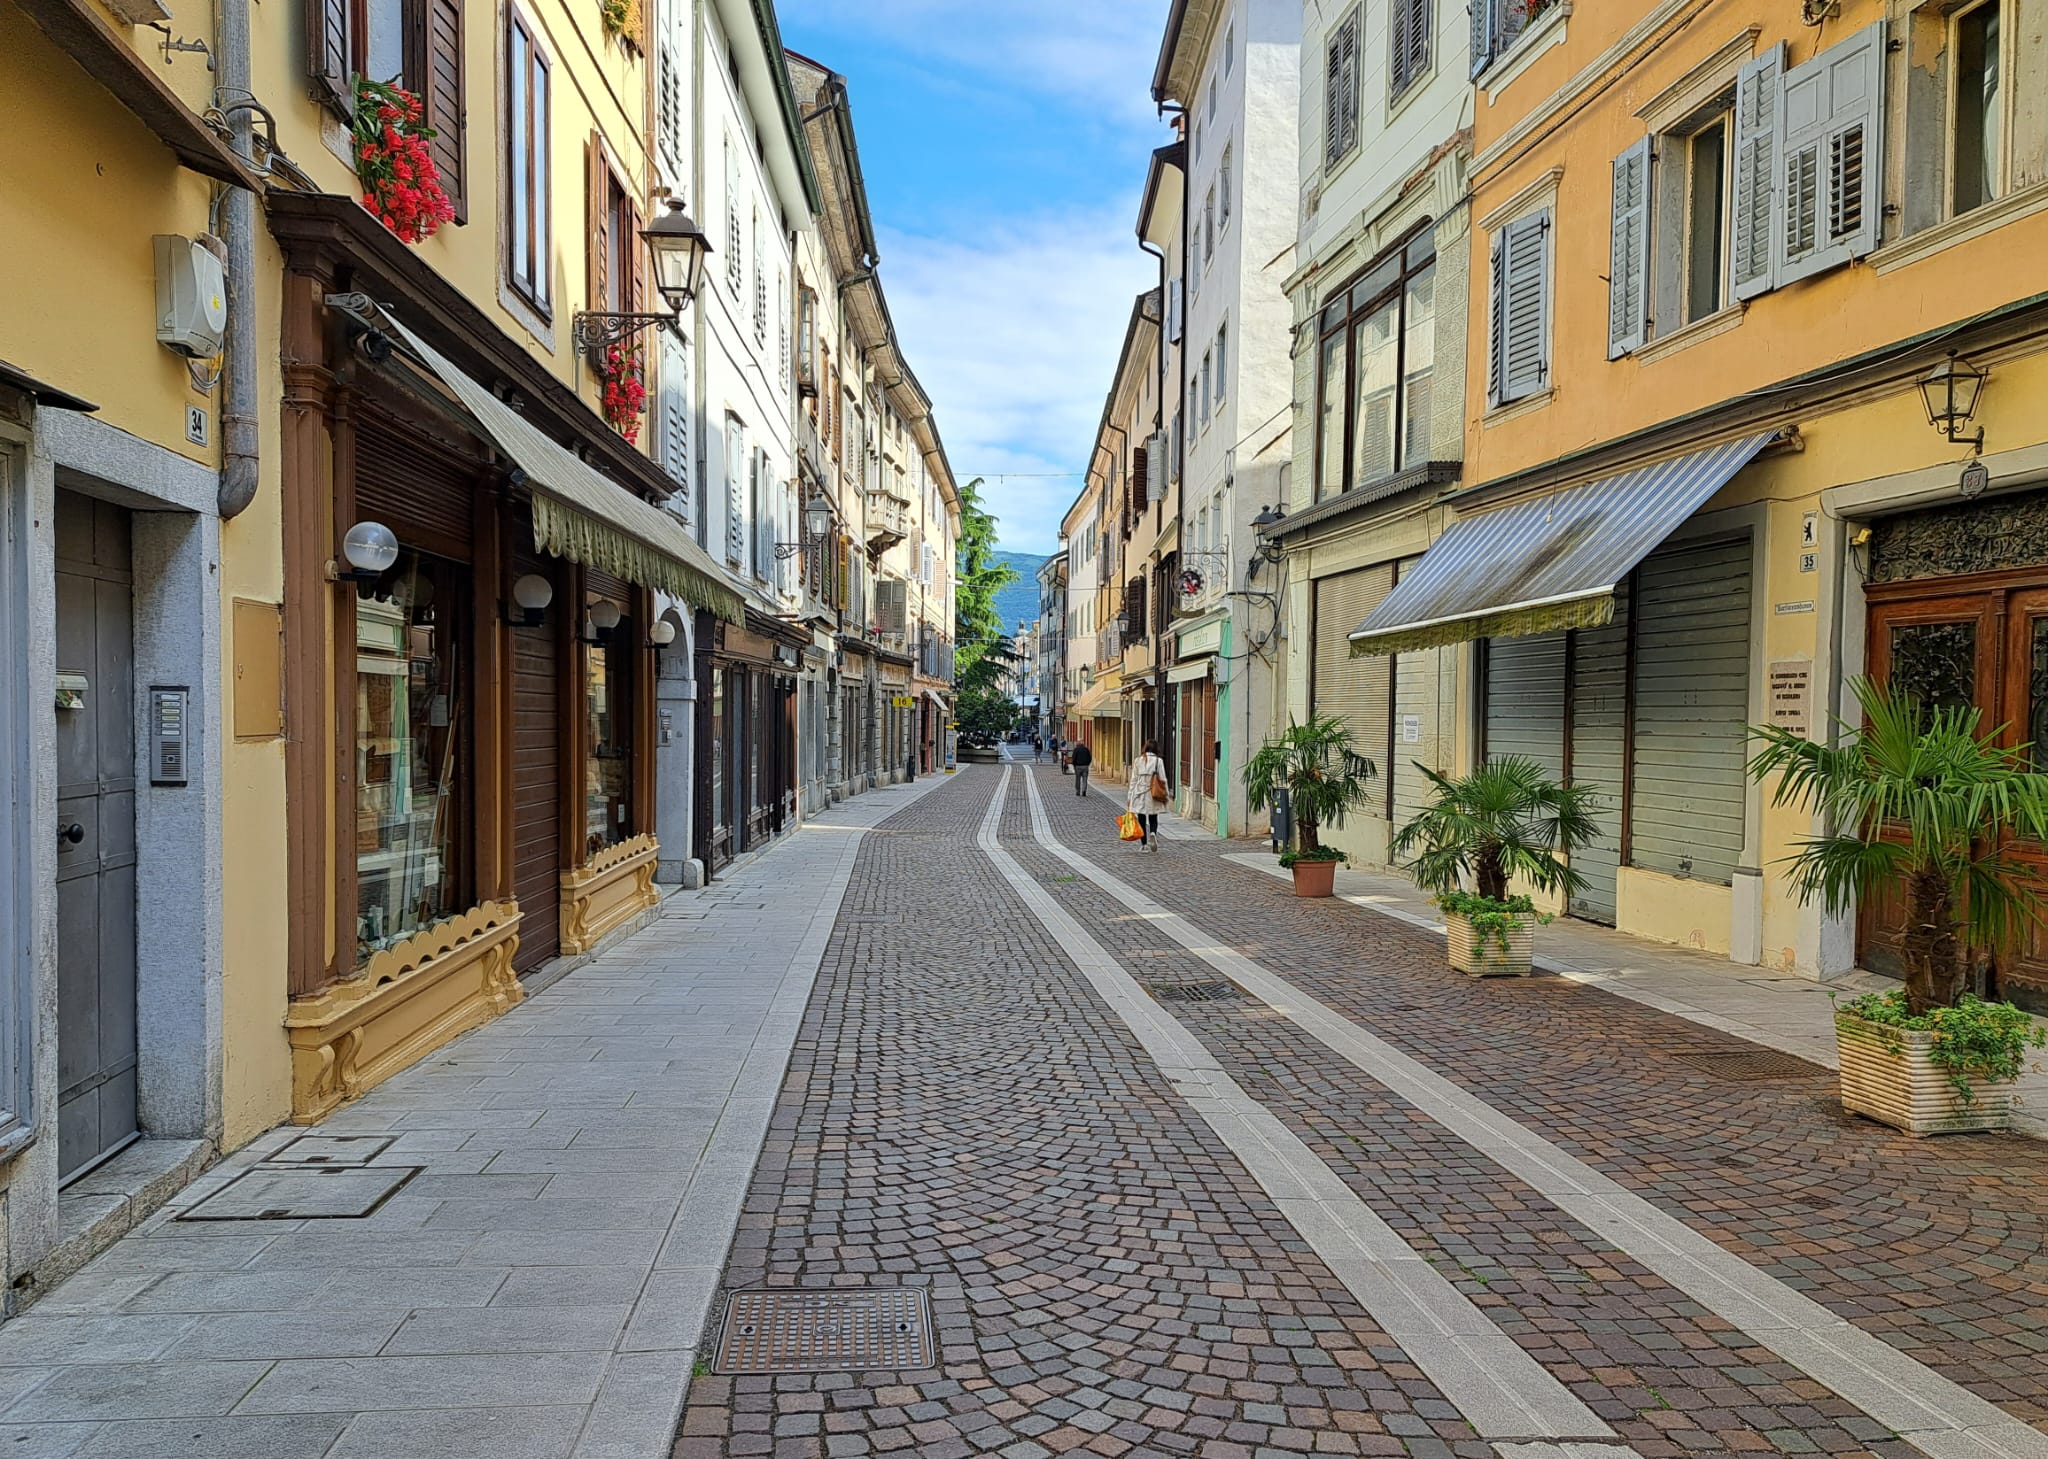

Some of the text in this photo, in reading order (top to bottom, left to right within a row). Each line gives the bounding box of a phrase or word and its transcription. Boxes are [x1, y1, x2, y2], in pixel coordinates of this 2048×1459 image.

[192, 410, 202, 435] 34
[1804, 555, 1814, 567] 35
[898, 698, 907, 706] 16
